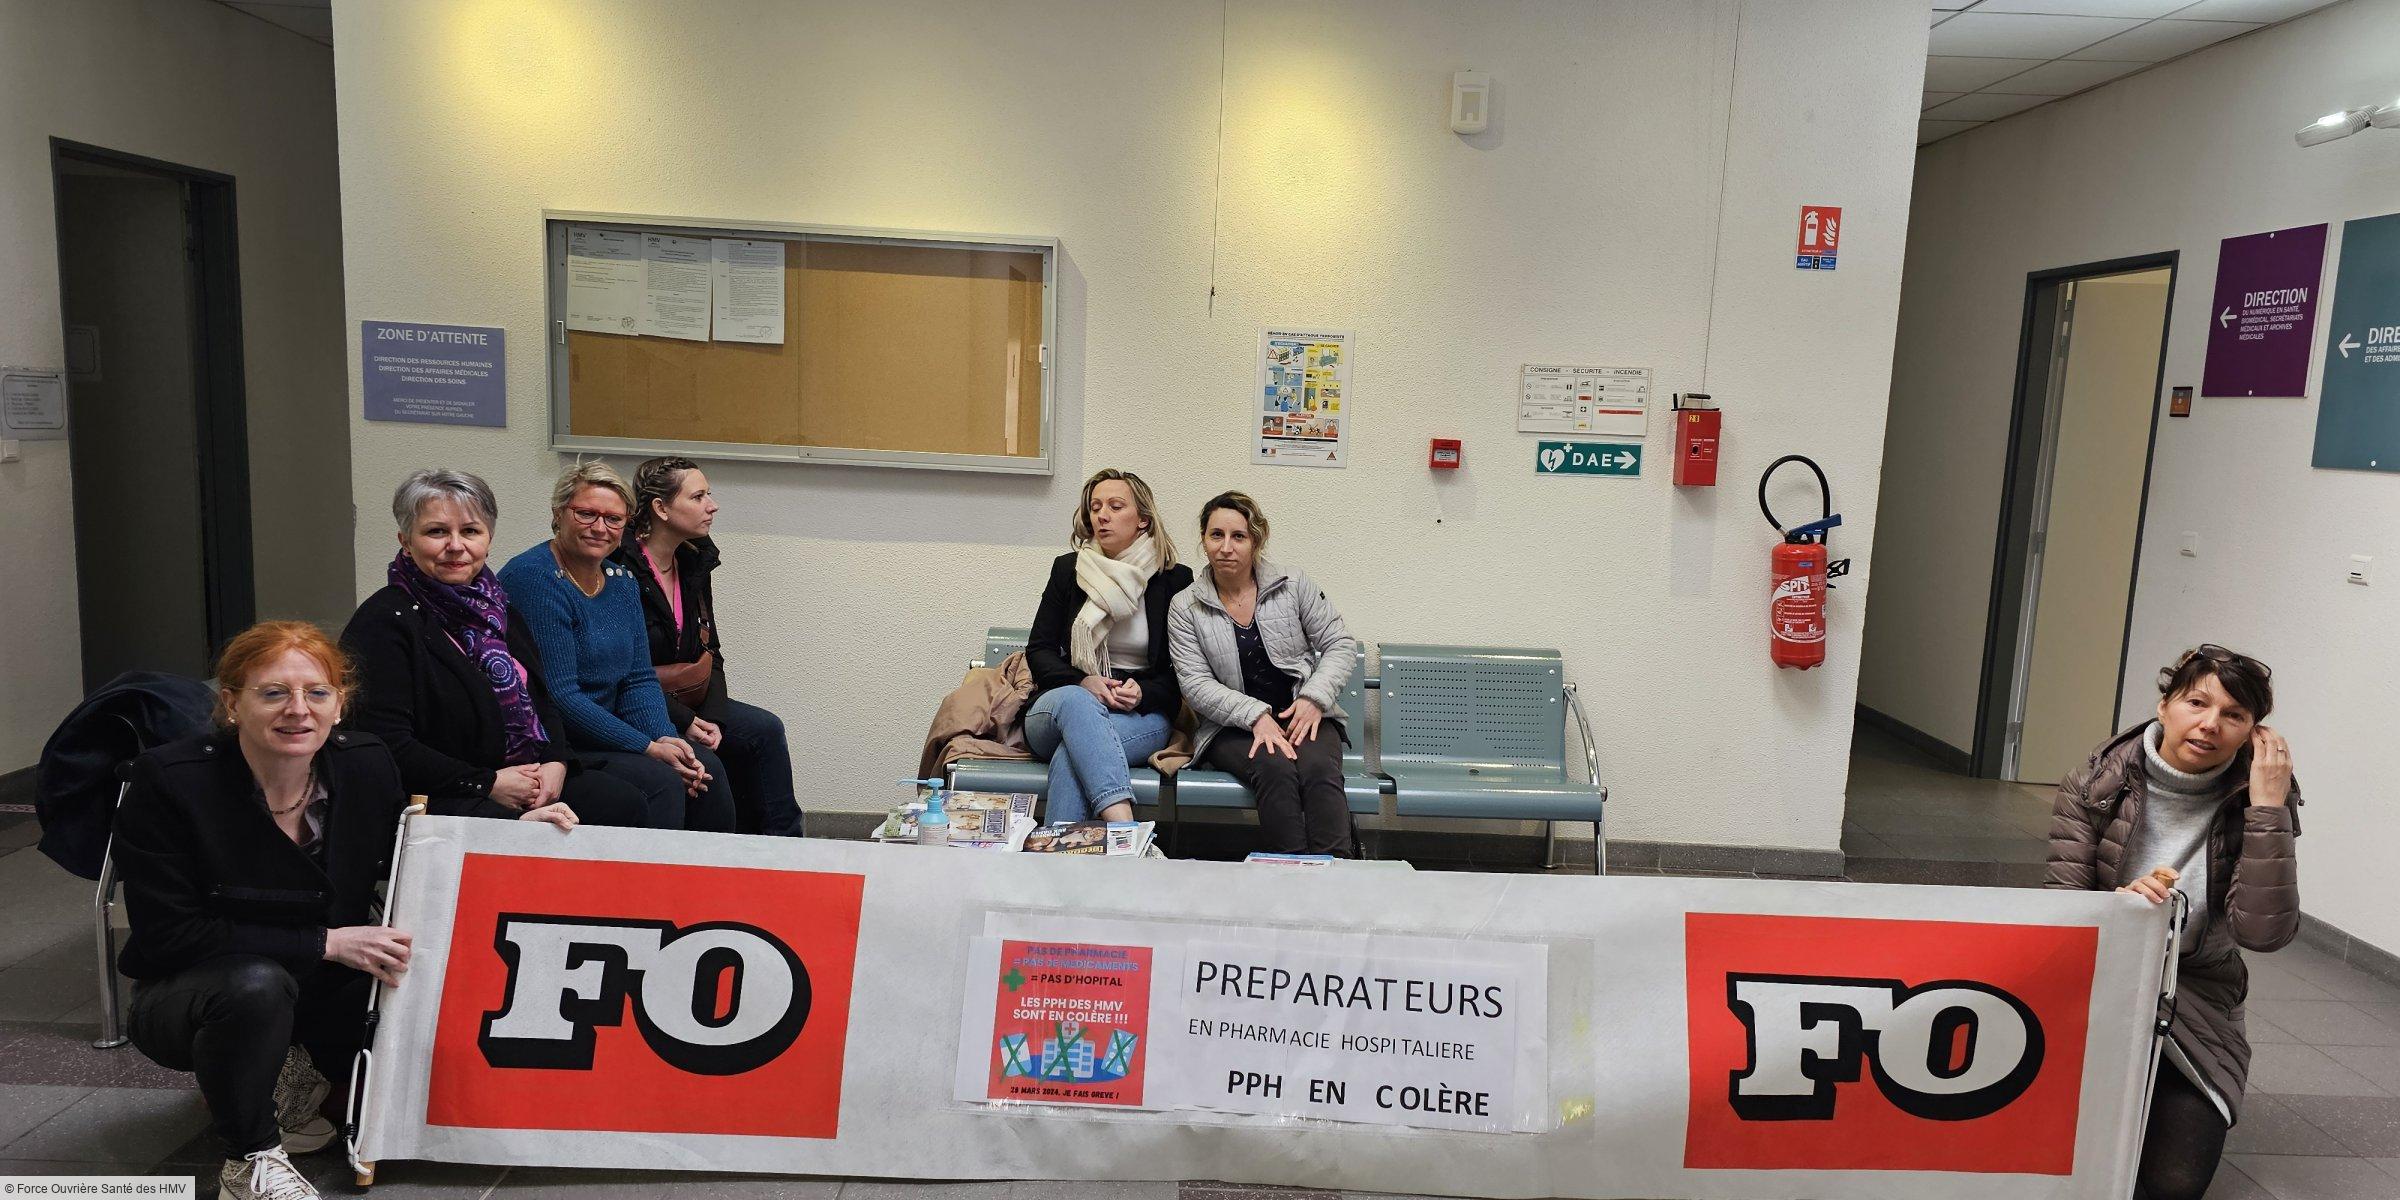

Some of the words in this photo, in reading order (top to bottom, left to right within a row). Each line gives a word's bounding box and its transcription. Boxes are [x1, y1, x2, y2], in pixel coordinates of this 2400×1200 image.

[2244, 288, 2308, 307] DIRECTION
[2250, 307, 2276, 316] NUMÉRIQUE
[378, 328, 414, 341] ZONE
[418, 330, 488, 345] D'ATTENTE
[2368, 326, 2400, 344] DIRE
[421, 358, 460, 366] RESSOURCES
[1572, 453, 1612, 467] DAE
[1780, 580, 1809, 592] SPIT
[1050, 948, 1062, 956] DE
[1064, 948, 1128, 958] PHARMACIE
[1023, 958, 1043, 967] PAS
[1041, 974, 1062, 984] PAS
[1064, 975, 1123, 987] D'HOPITAL
[477, 912, 812, 1076] FO
[1196, 961, 1503, 1018] PREPARATEURS
[1021, 997, 1041, 1007] LES
[1043, 999, 1066, 1009] PPH
[1069, 1000, 1091, 1010] DES
[1094, 1001, 1123, 1011] HMV
[1013, 1009, 1046, 1020] SONT
[1049, 1011, 1064, 1021] EN
[1067, 1010, 1111, 1023] COLÈRE
[1189, 1018, 1212, 1036] EN
[1220, 1022, 1330, 1048] PHARMACIE
[1726, 972, 2045, 1120] FO
[1021, 1087, 1040, 1095] MARS
[1228, 1070, 1282, 1099] PPH
[1310, 1080, 1346, 1105] EN
[1376, 1082, 1489, 1116] COLÈRE
